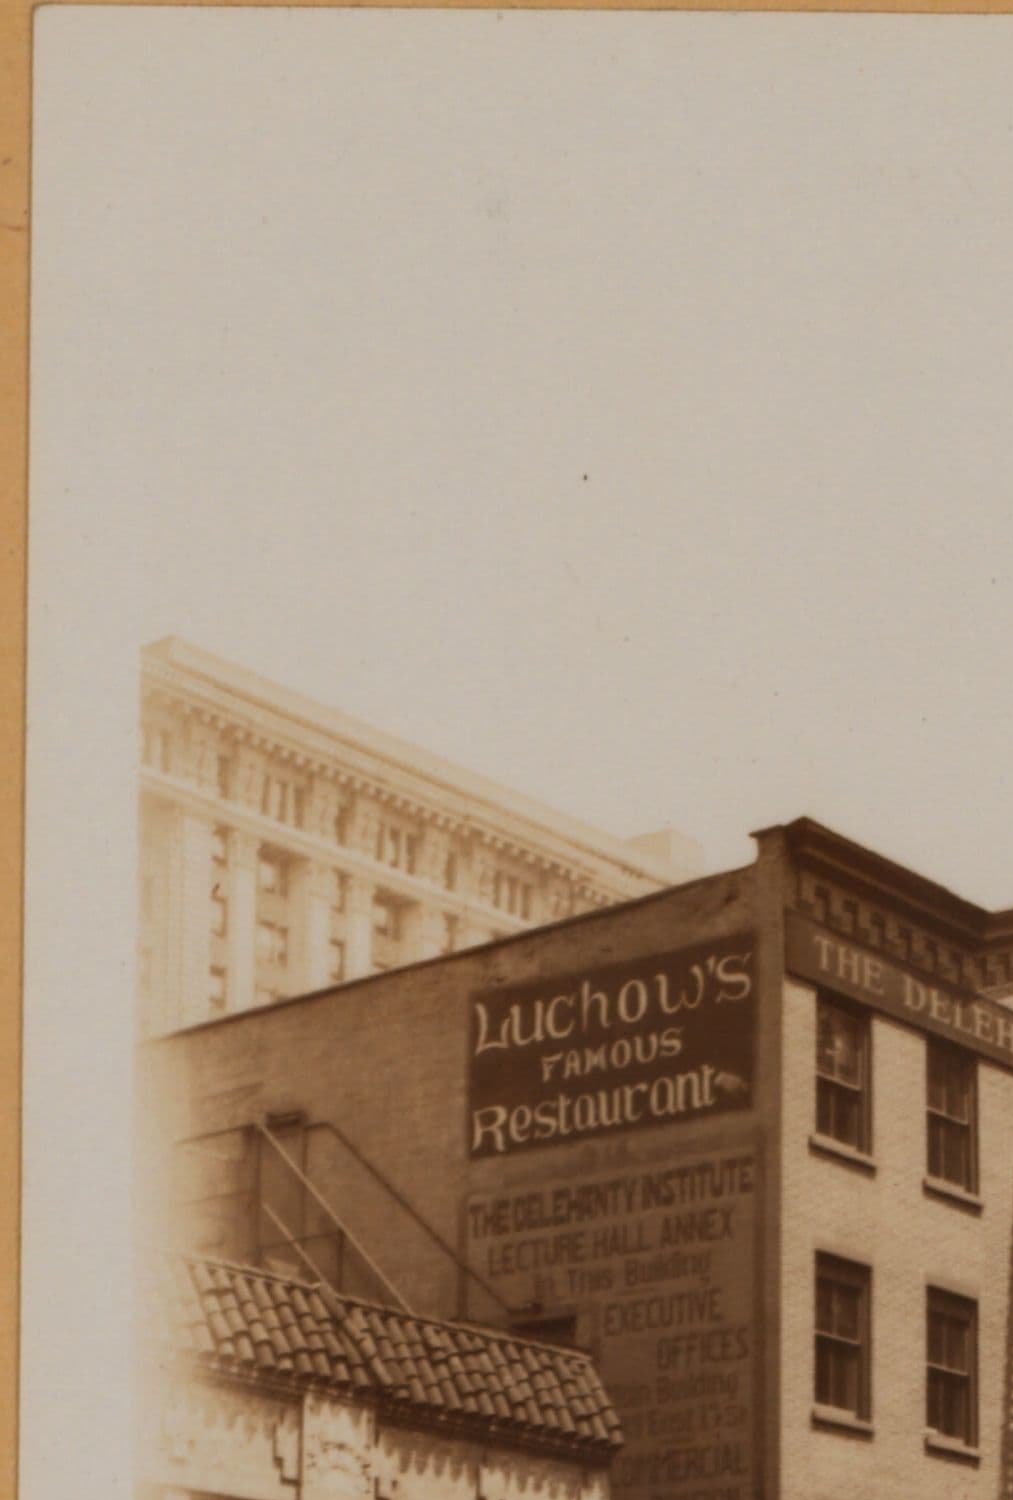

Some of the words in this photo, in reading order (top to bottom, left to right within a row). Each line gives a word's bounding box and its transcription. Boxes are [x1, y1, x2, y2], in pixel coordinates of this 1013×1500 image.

[812, 933, 885, 996] THE
[540, 1026, 684, 1082] FAMOUS
[471, 1063, 716, 1151] Restaurant
[469, 1199, 509, 1239] THE
[641, 1155, 754, 1208] INSTITUTE
[487, 1230, 586, 1278] LECTURE
[592, 1221, 651, 1258] HALL
[659, 1206, 734, 1249] ANNEX
[603, 1287, 723, 1338] EXECUTIVE
[656, 1327, 749, 1370] OFFICES
